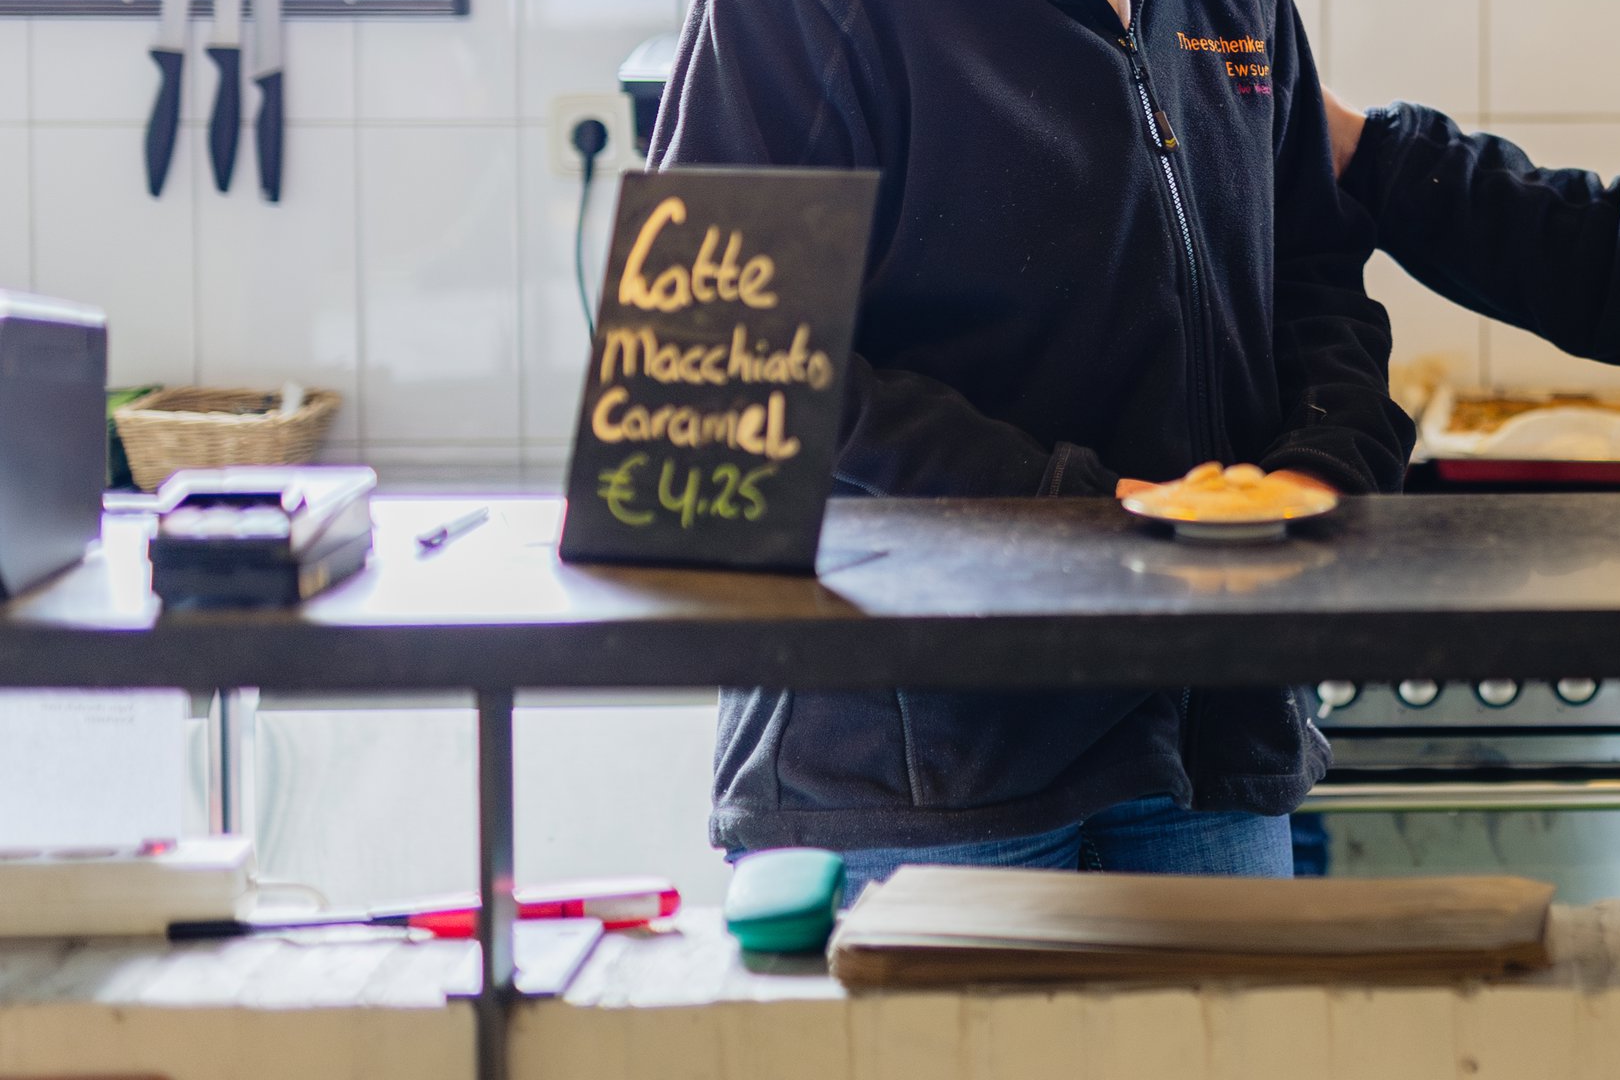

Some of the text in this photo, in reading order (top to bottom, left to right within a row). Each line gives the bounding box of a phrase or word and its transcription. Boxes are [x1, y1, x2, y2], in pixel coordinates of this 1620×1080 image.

[619, 196, 779, 312] Latte
[601, 323, 833, 390] Macchiato
[591, 386, 800, 461] Caramel
